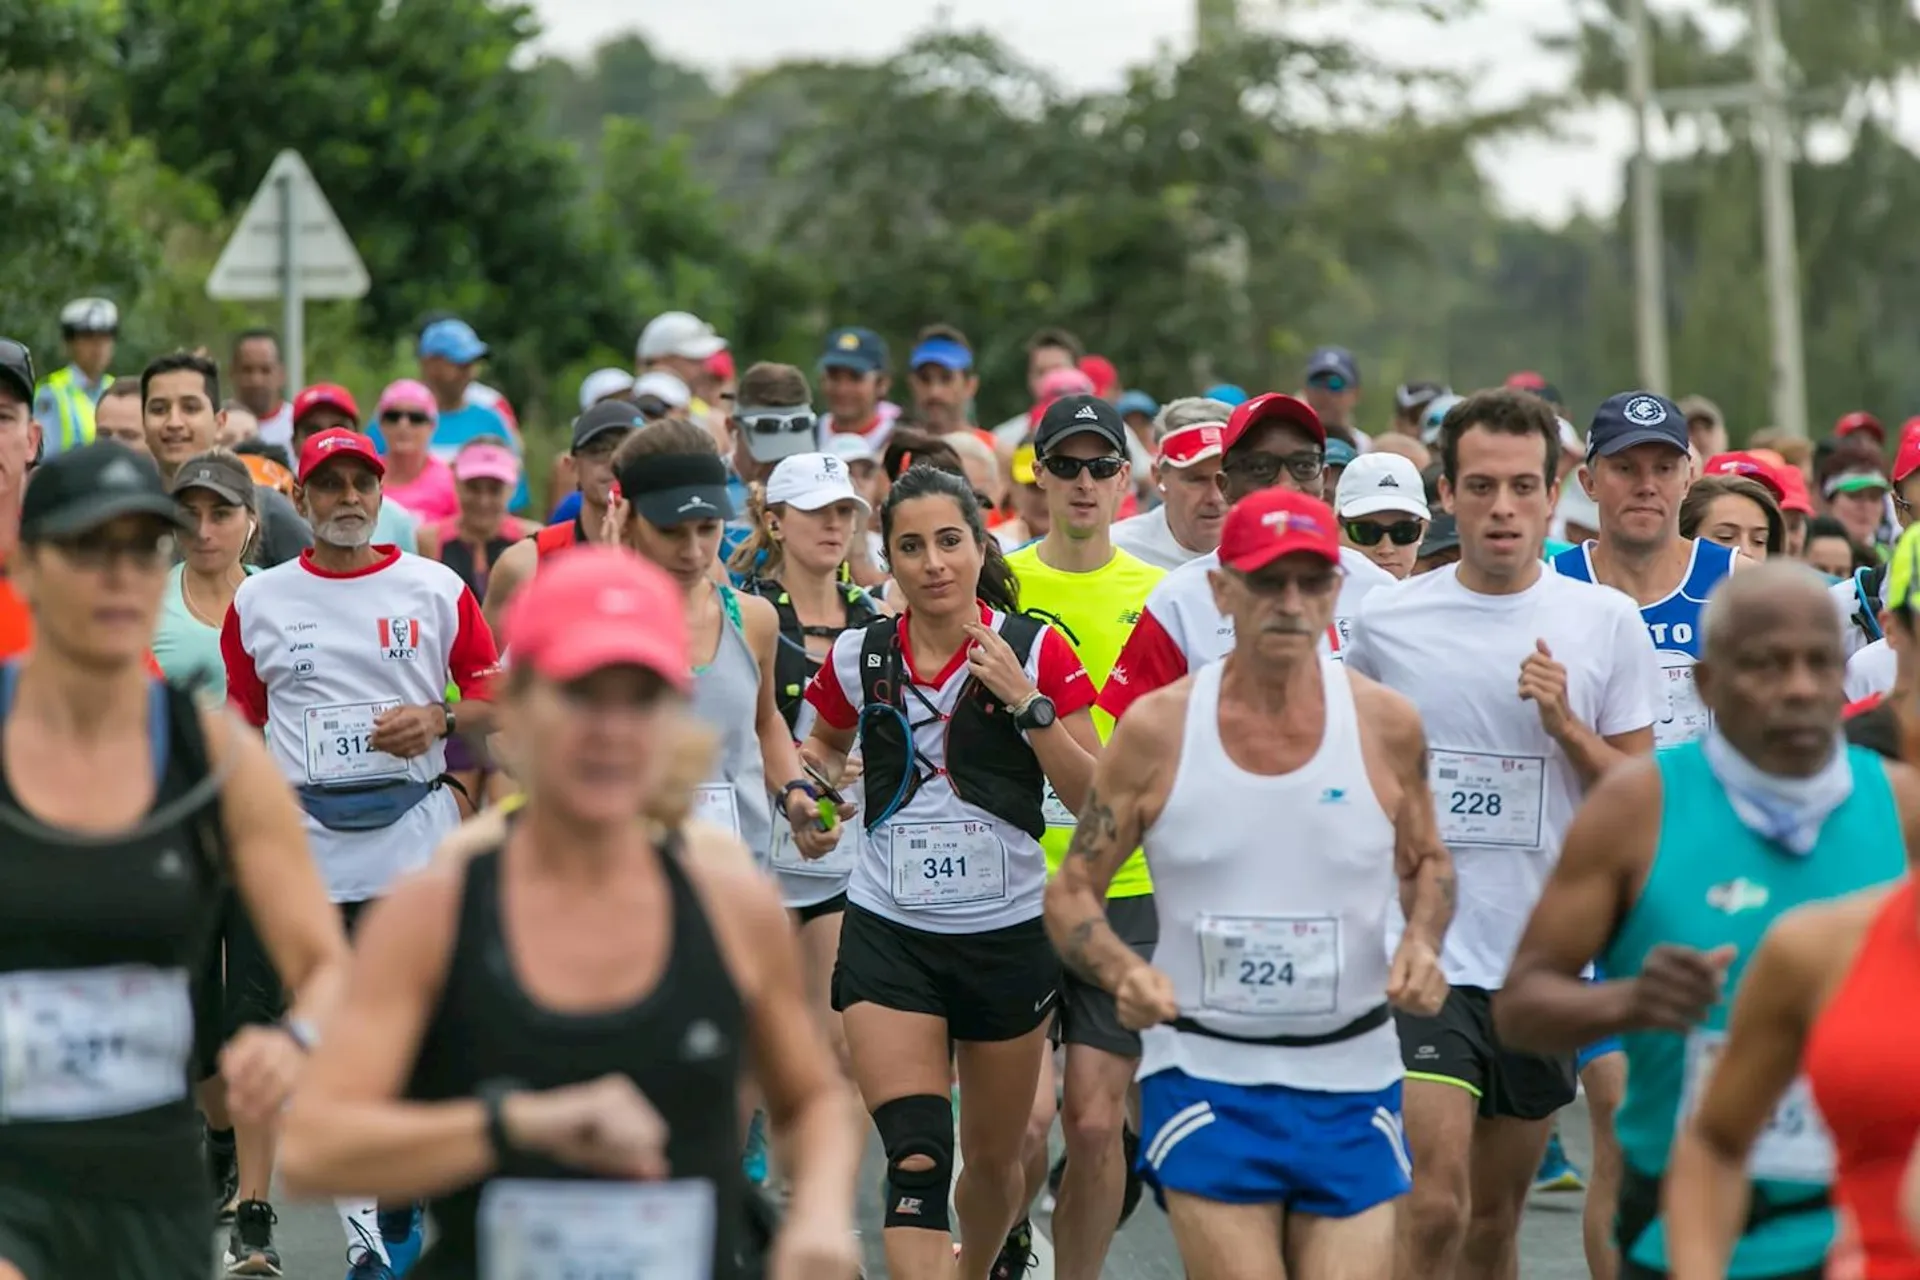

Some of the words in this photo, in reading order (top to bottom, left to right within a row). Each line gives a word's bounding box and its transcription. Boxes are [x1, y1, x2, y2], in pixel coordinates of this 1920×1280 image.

[389, 649, 414, 659] KFC
[1450, 790, 1502, 817] 228
[923, 855, 966, 879] 341
[1239, 960, 1294, 986] 224
